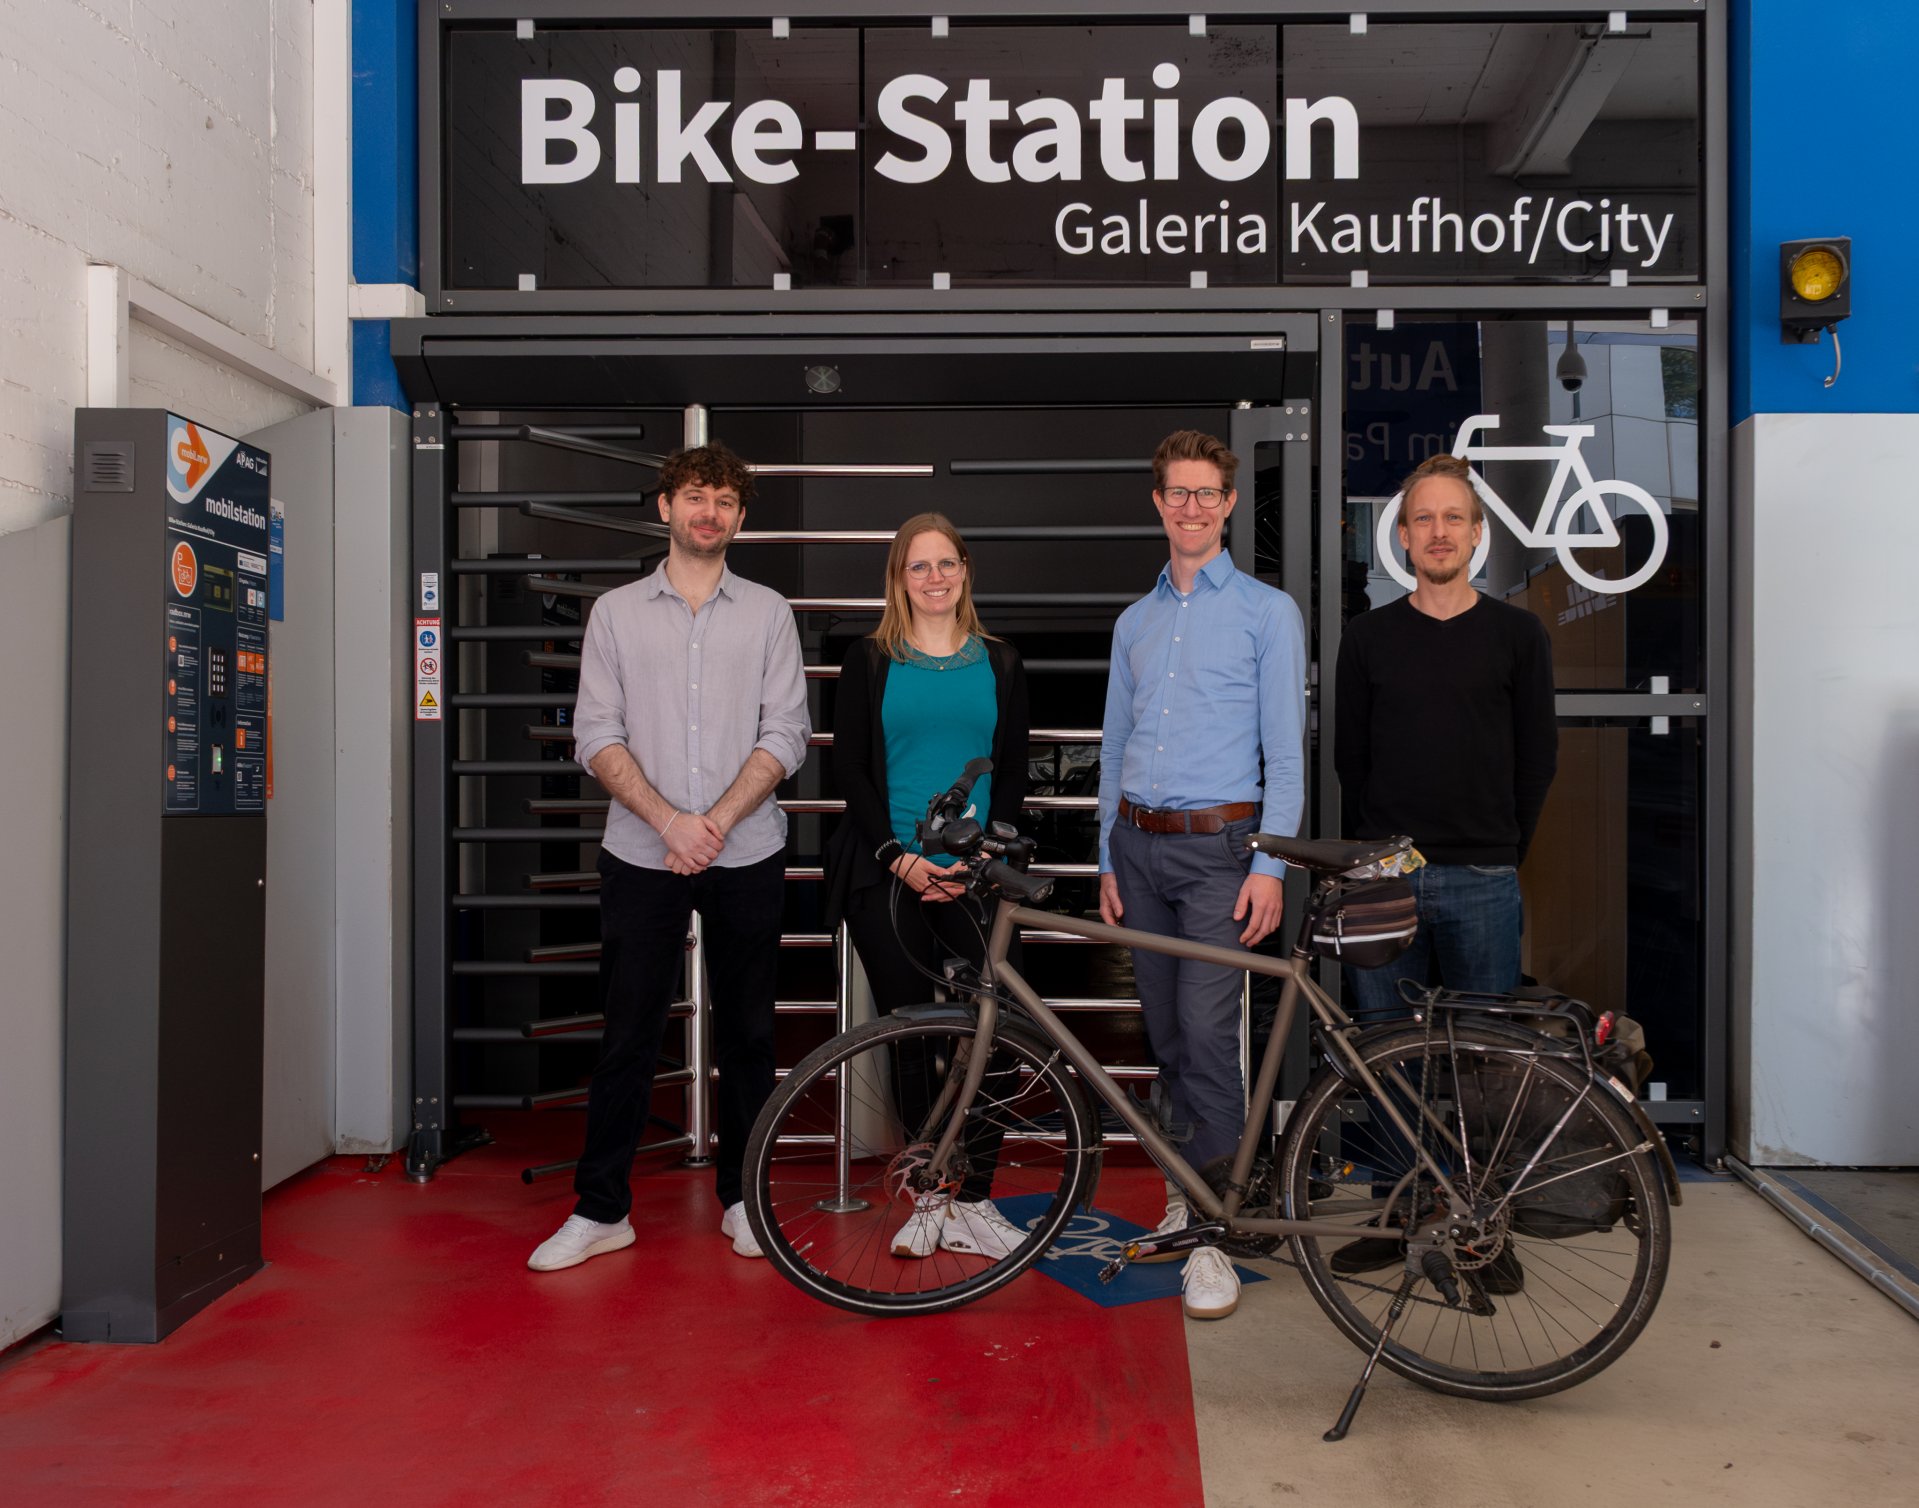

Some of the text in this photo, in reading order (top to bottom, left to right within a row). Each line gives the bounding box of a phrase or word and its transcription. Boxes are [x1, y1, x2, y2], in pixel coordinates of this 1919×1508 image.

[521, 63, 1359, 184] Bike-Station
[1055, 196, 1674, 267] Galeria Kaufhof/City
[205, 497, 266, 530] mobilstation
